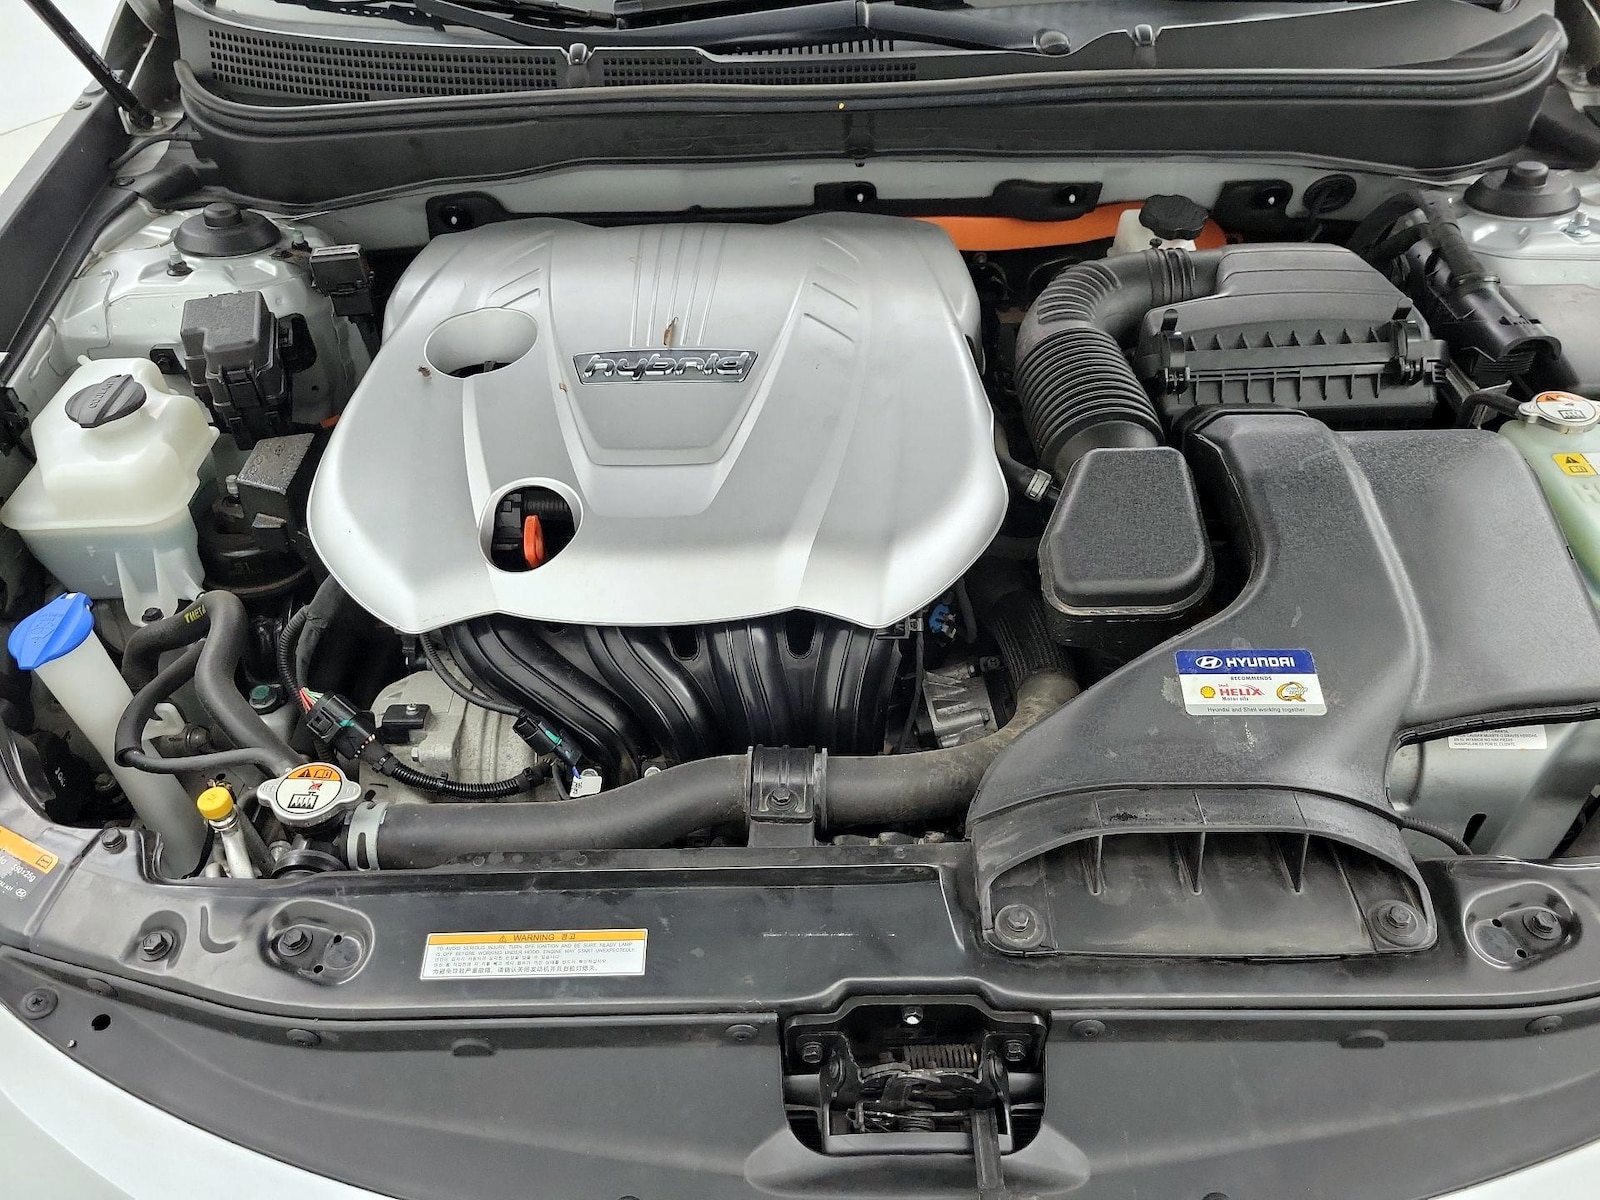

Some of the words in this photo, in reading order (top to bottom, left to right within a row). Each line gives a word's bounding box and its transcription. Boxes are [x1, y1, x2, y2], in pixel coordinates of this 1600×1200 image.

[582, 352, 751, 381] hybrid
[1226, 656, 1296, 668] HYUNDAI
[1219, 688, 1263, 696] HELIX
[513, 934, 555, 942] WARNING
